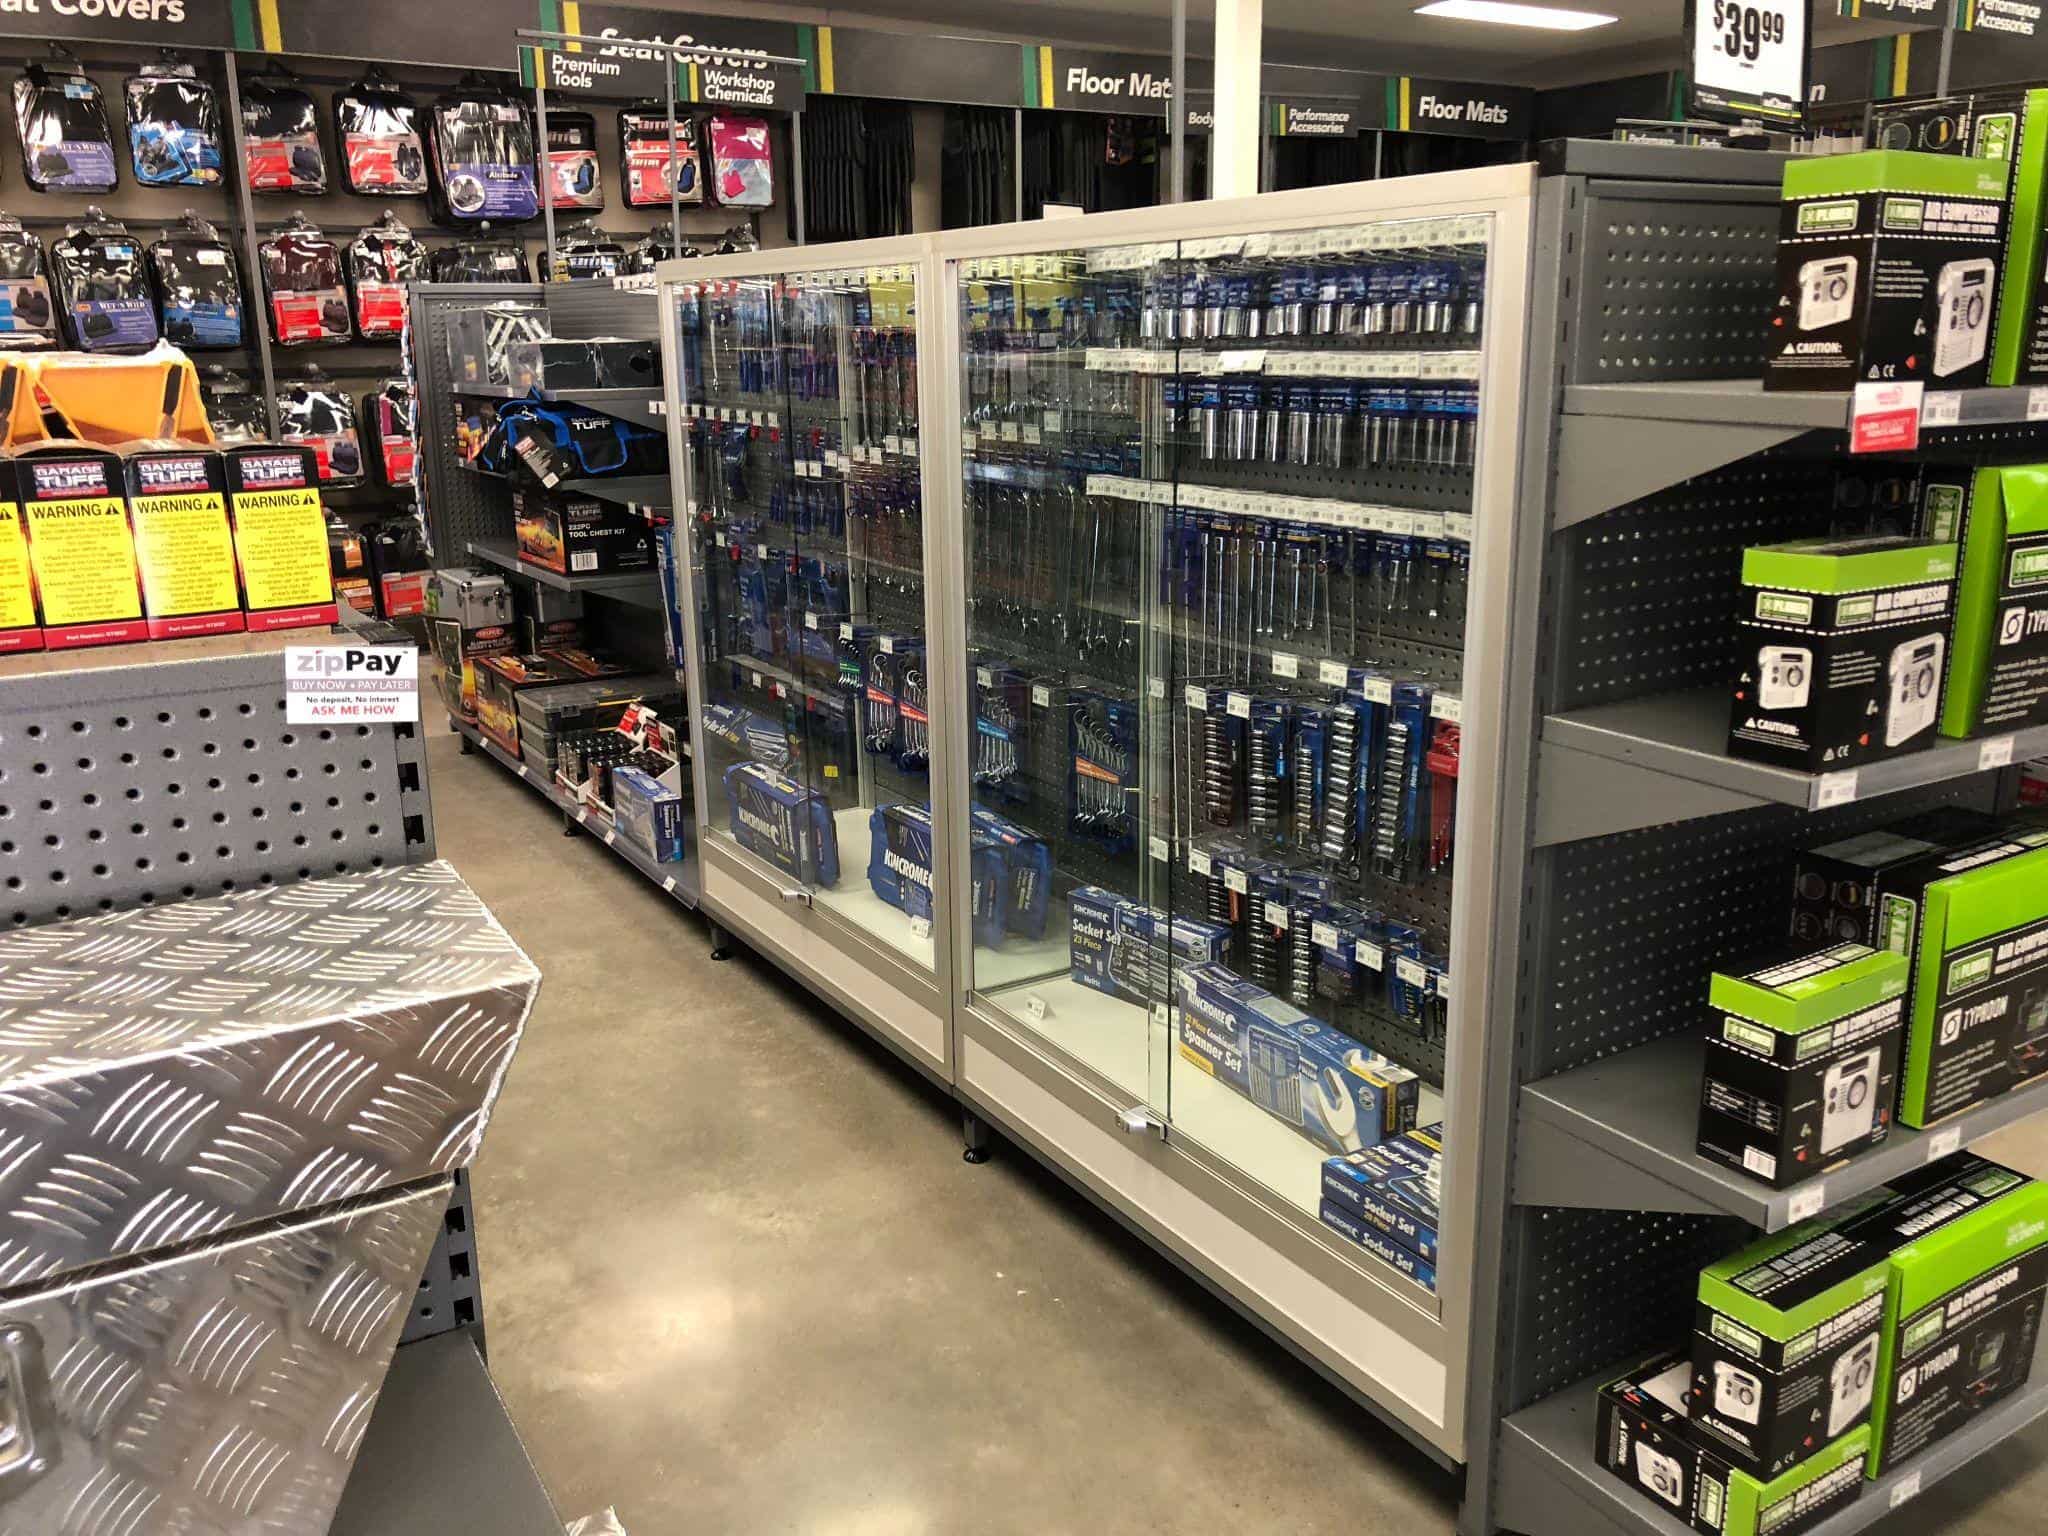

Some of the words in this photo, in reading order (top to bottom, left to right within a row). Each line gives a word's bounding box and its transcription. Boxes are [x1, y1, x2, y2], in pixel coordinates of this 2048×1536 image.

[1975, 11, 2034, 36] Accessories
[599, 27, 665, 62] Seat
[551, 54, 620, 76] Premium
[554, 70, 593, 88] Tools
[704, 69, 775, 91] Workshop
[1066, 67, 1125, 95] Floor
[1128, 72, 1173, 98] Mat
[704, 84, 774, 105] Chemicals
[1289, 108, 1350, 123] Performance
[1418, 95, 1464, 120] Floor
[1465, 100, 1509, 124] Mats
[1188, 112, 1215, 128] Body
[1288, 121, 1345, 134] Accessories
[1796, 342, 1843, 354] CAUTION:
[38, 474, 104, 489] TUFF
[143, 469, 205, 484] TUFF
[244, 466, 303, 481] TUFF
[137, 498, 203, 514] WARNING
[239, 494, 300, 510] WARNING
[32, 503, 102, 520] WARNING
[297, 650, 402, 676] zipPay
[292, 680, 316, 690] BUY
[316, 680, 346, 690] NOW
[358, 680, 379, 690] PAY
[379, 680, 411, 690] LATER
[321, 696, 353, 704] deposit,
[312, 706, 336, 716] ASK
[340, 706, 360, 715] ME
[363, 705, 396, 715] HOW
[884, 849, 930, 887] KINCROME
[1072, 918, 1104, 940] Socket
[1105, 929, 1122, 946] Set
[1083, 937, 1102, 951] Piece
[1187, 990, 1226, 1022] KINCROME
[1184, 1023, 1223, 1061] Spanner
[1224, 1051, 1242, 1073] Set
[1364, 1197, 1397, 1224] Socket
[1398, 1216, 1416, 1236] Set
[1362, 1232, 1395, 1262] Socket
[1395, 1253, 1414, 1273] Set
